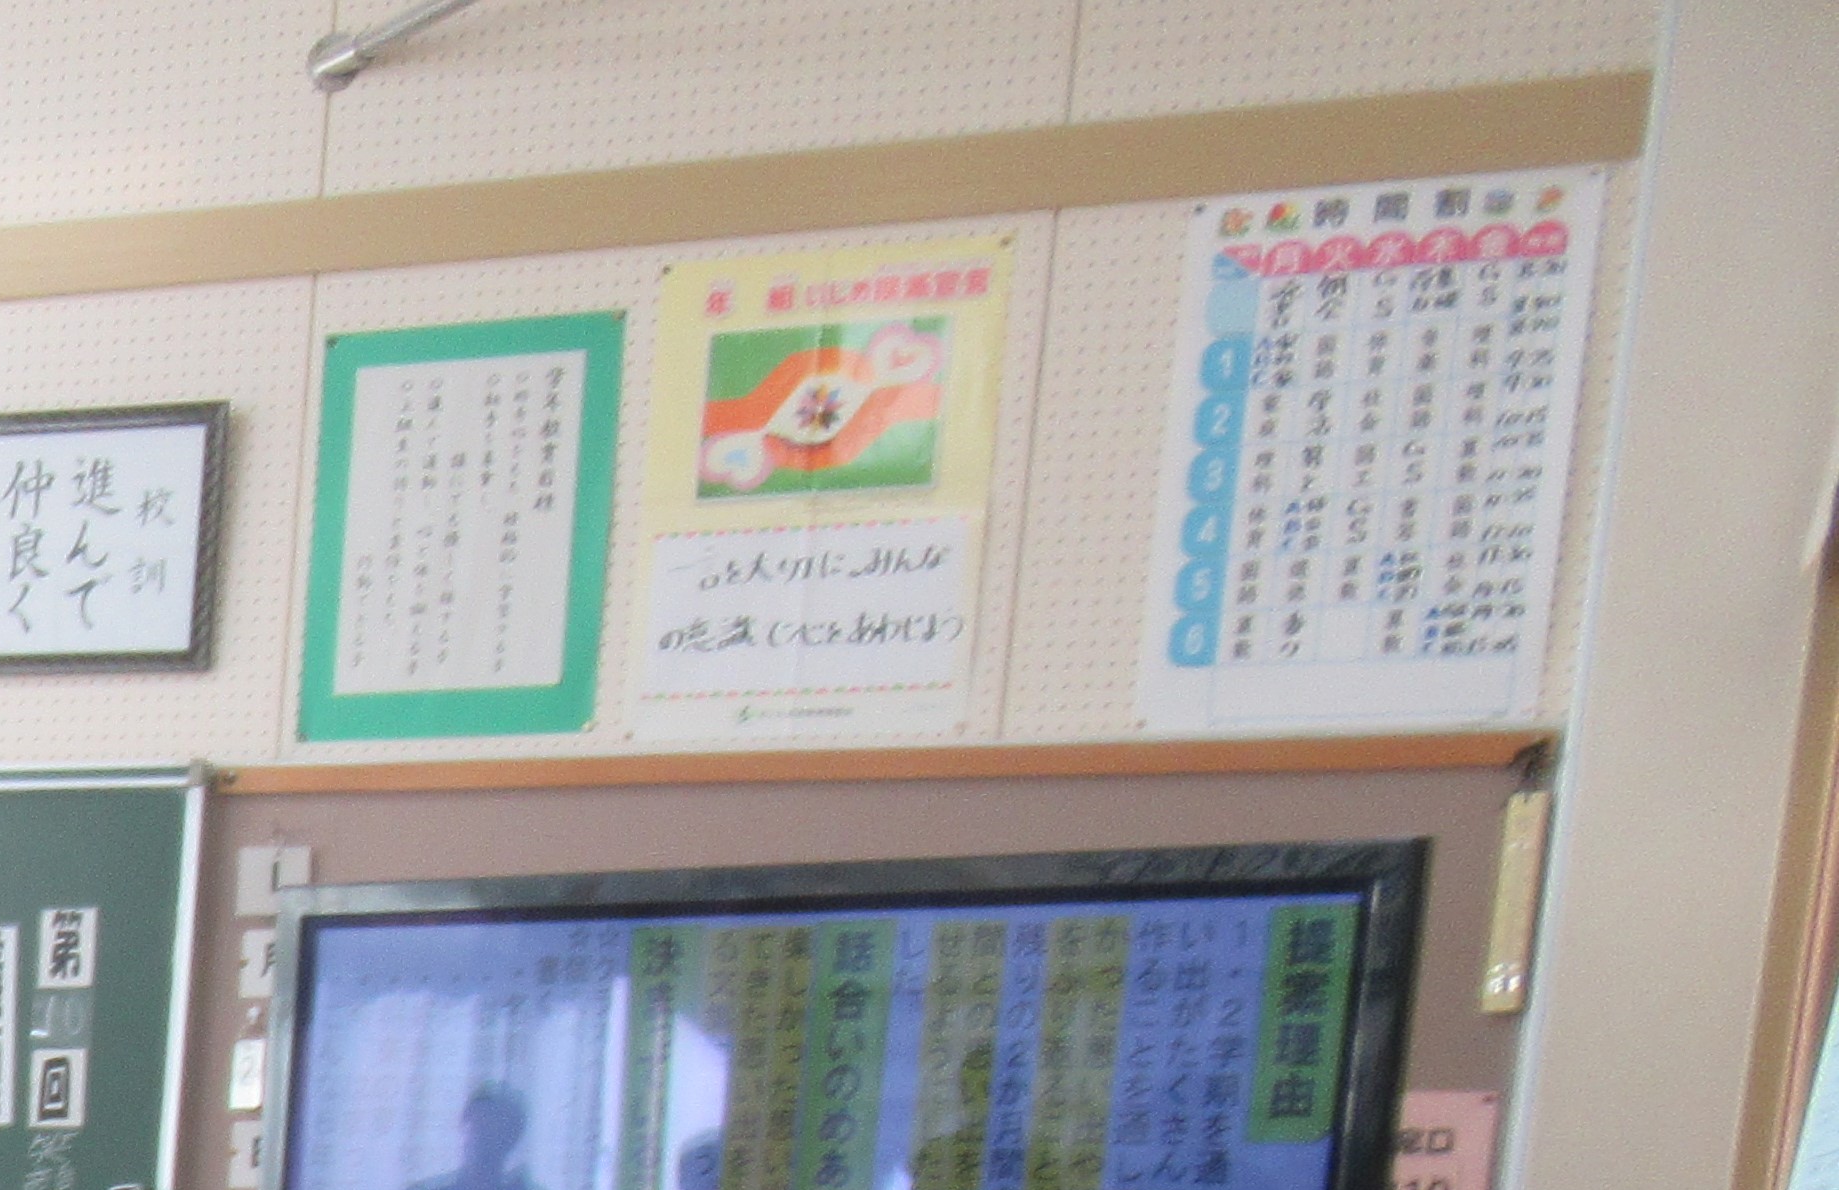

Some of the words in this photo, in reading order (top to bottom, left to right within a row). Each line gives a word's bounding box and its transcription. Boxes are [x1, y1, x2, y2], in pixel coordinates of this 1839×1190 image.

[1216, 347, 1233, 379] 1
[1209, 405, 1231, 436] 2
[0, 457, 55, 634] 仲良く
[63, 457, 120, 631] 進んで
[133, 487, 175, 596] 校訓
[1197, 515, 1217, 543] 4
[1267, 917, 1337, 1120] 提案理由
